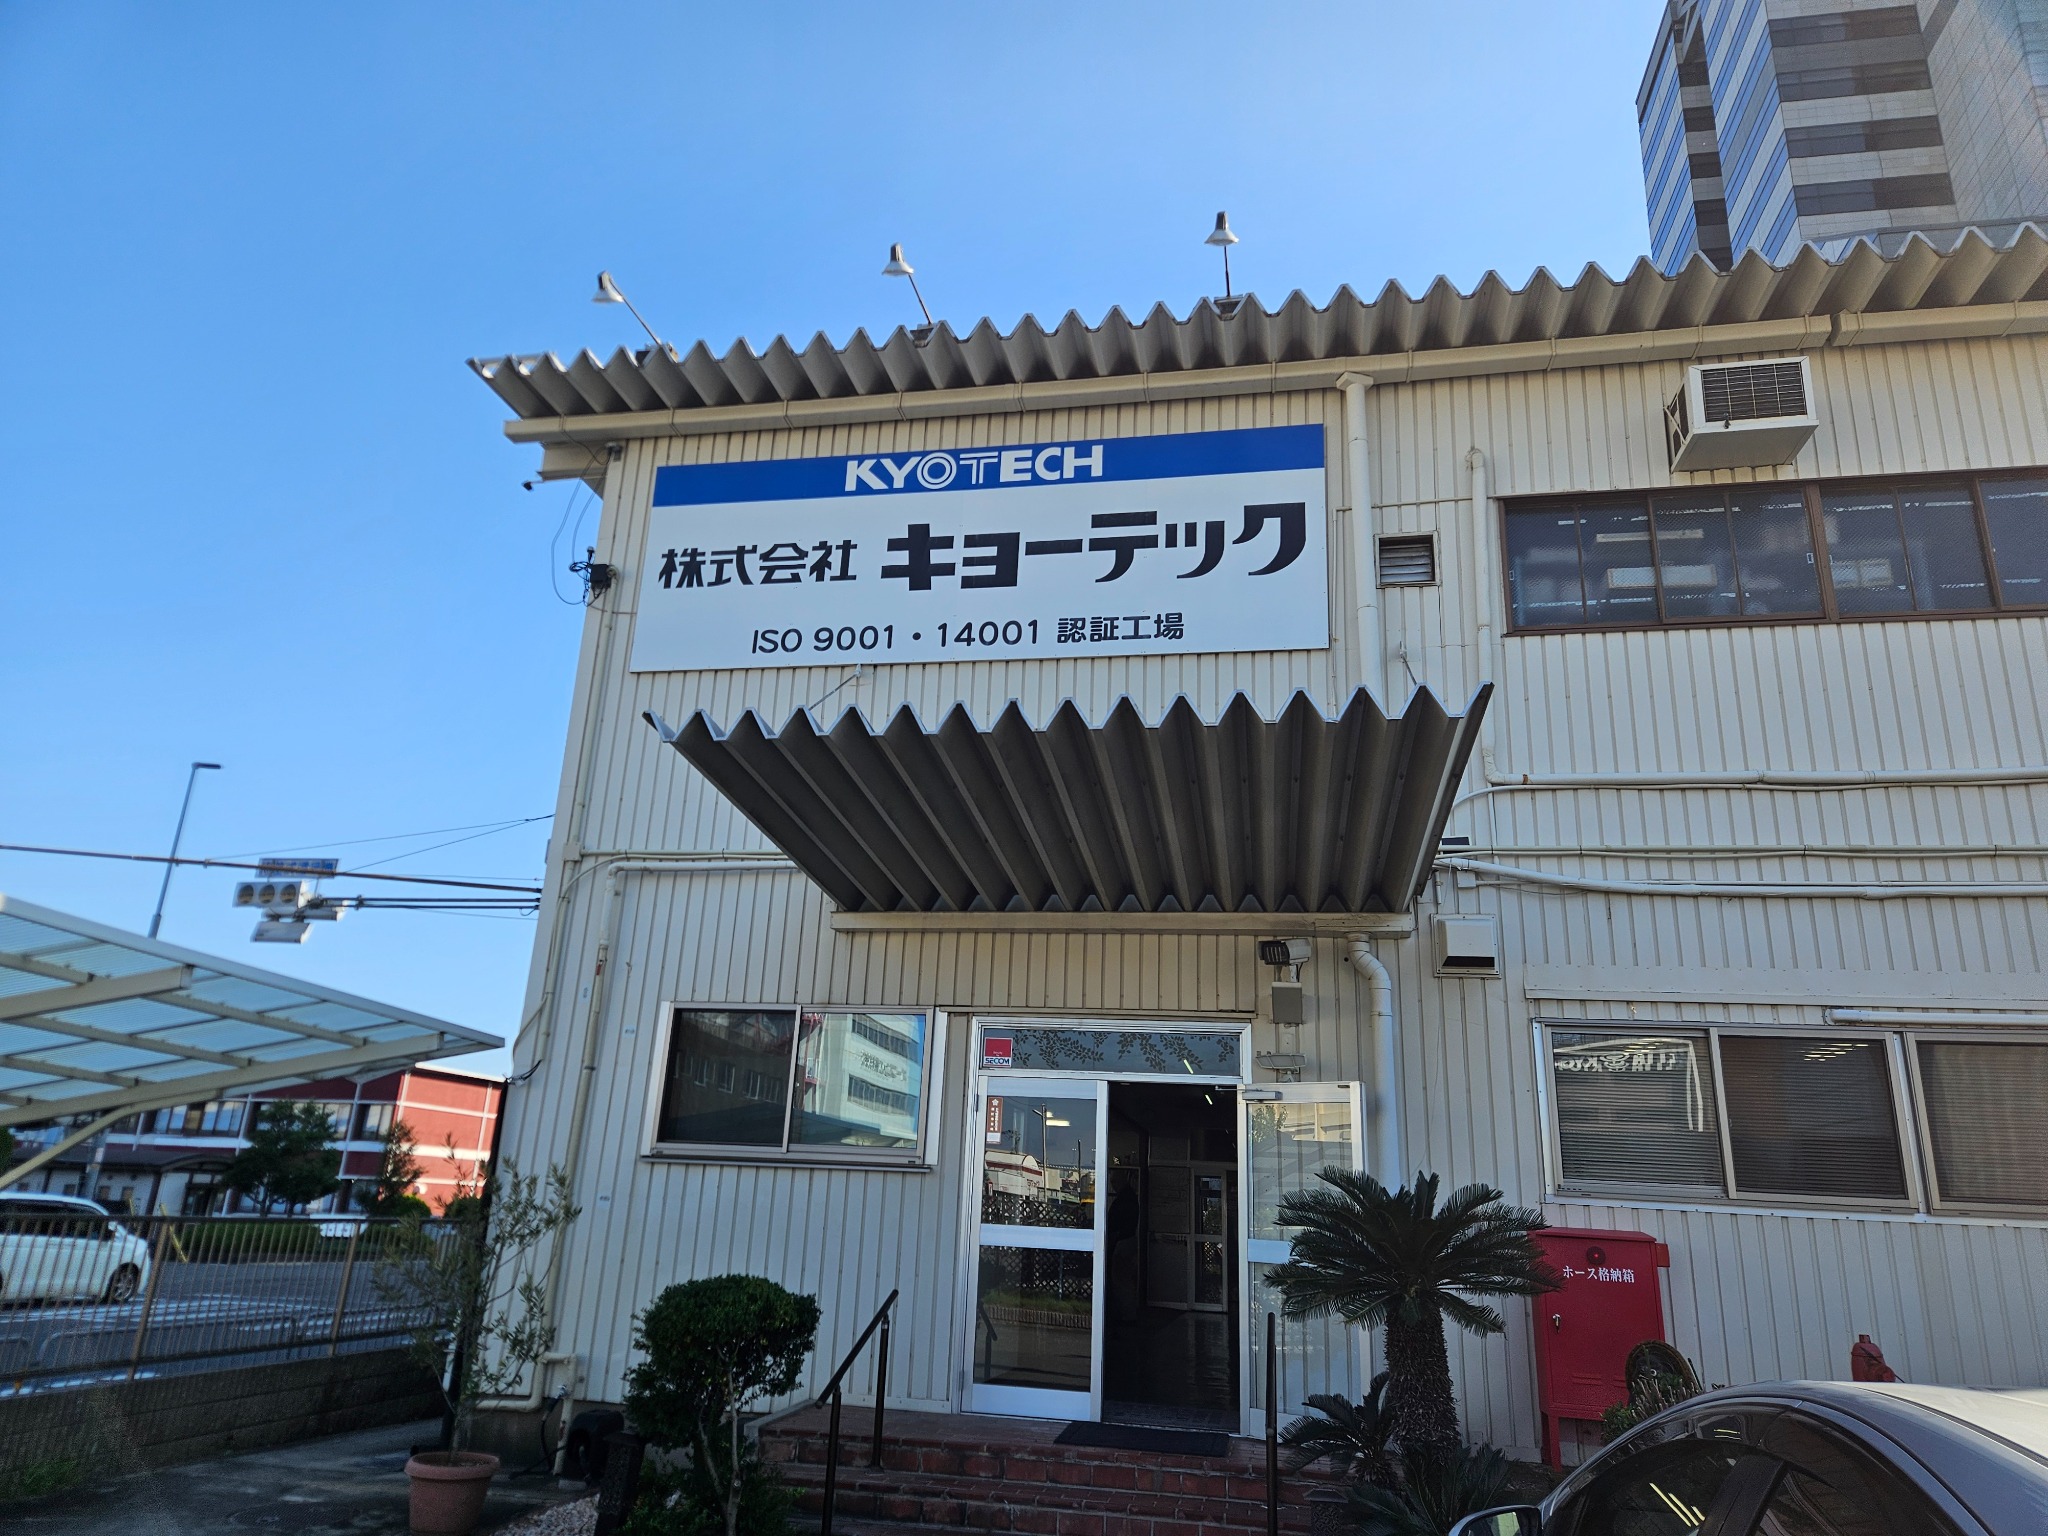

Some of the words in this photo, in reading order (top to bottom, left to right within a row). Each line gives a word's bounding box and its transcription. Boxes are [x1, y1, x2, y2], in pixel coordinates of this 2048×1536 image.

[844, 444, 1104, 491] KYOTECH
[659, 540, 857, 589] 株式会社
[881, 502, 1306, 591] キョーテック
[752, 629, 802, 654] ISO
[1057, 612, 1185, 643] 認証工場
[985, 1058, 1010, 1066] SECOM
[1563, 1265, 1635, 1283] ホース格納箱
